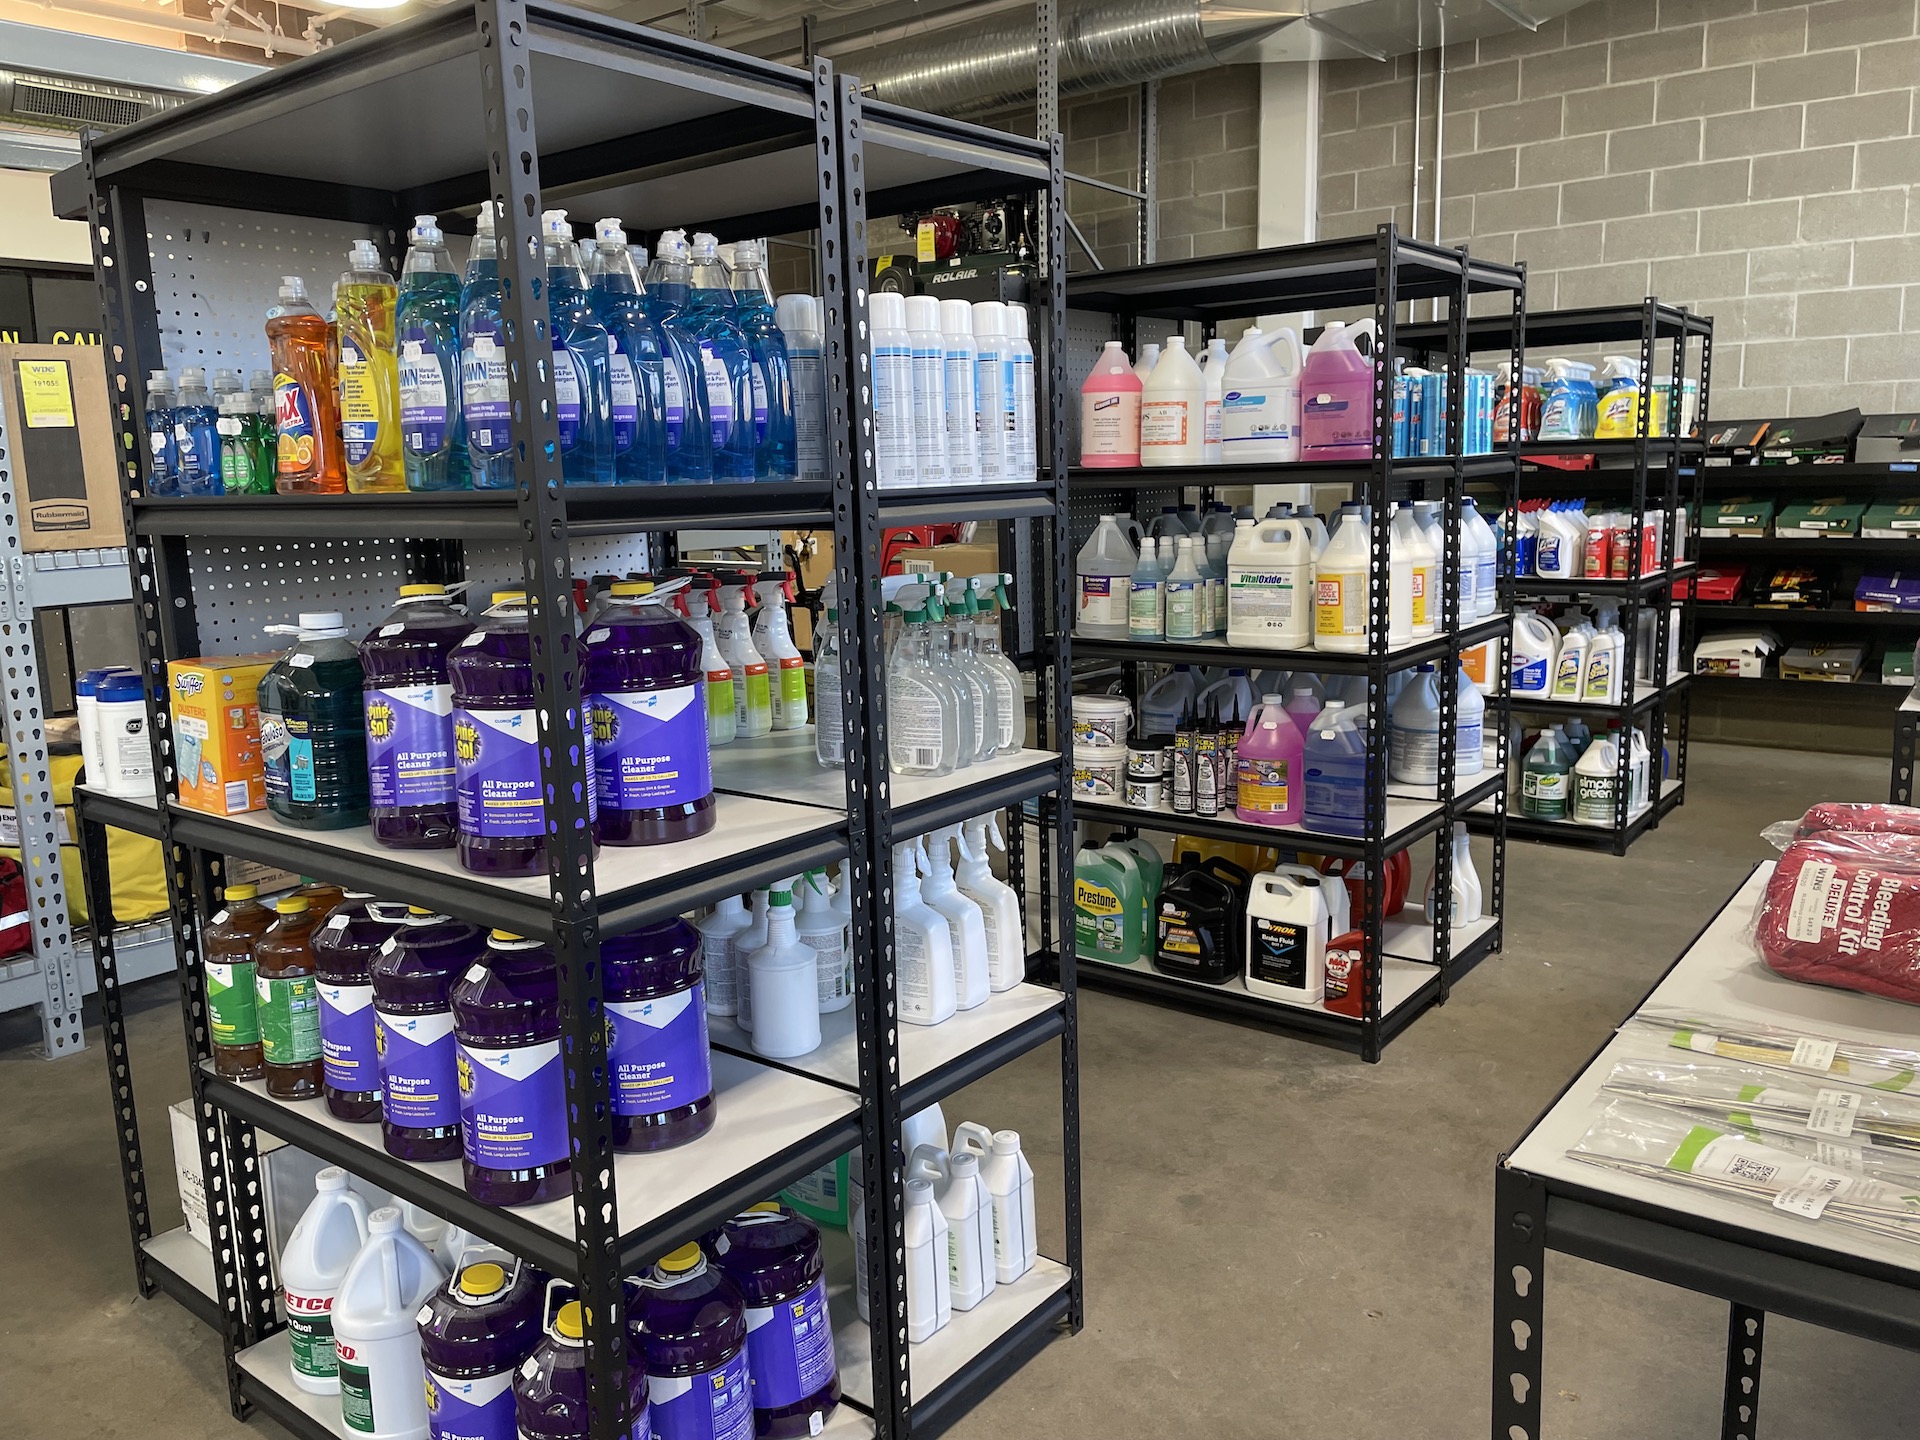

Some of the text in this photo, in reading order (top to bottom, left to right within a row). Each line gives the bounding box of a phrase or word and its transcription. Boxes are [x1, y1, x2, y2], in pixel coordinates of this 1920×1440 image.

[933, 269, 977, 284] ROLAIR
[419, 379, 442, 387] Detergent
[285, 418, 303, 429] ULTRA
[36, 511, 85, 519] Rubbermaid
[175, 673, 204, 696] Swiffer
[177, 703, 207, 717] DUSTERS
[368, 704, 392, 720] Pine-
[369, 719, 390, 737] Sol
[455, 723, 478, 741] Pine-
[397, 750, 447, 761] All Purpose
[456, 740, 474, 759] Sol
[397, 760, 432, 770] Cleaner
[621, 755, 671, 766] All Purpose
[622, 765, 656, 774] Cleaner
[482, 780, 535, 790] All Purpose
[1580, 777, 1614, 790] simple
[482, 789, 517, 798] Cleaner
[1580, 787, 1613, 800] green
[1812, 867, 1828, 891] WINS
[1078, 886, 1116, 908] Prestone
[1822, 883, 1843, 923] DELUXE
[1837, 868, 1879, 955] Control Kit
[1861, 878, 1902, 951] Bleeding
[1262, 934, 1295, 946] Brake Fluid
[1328, 957, 1349, 969] MAX
[327, 1040, 351, 1052] Purpose
[618, 1061, 666, 1073] All Purpose
[397, 1076, 431, 1087] Purpose
[618, 1071, 651, 1081] Cleaner
[389, 1083, 415, 1093] Cleaner
[476, 1114, 524, 1125] All Purpose
[476, 1122, 507, 1132] Cleaner
[292, 1320, 313, 1333] Quat
[441, 1430, 452, 1438] All
